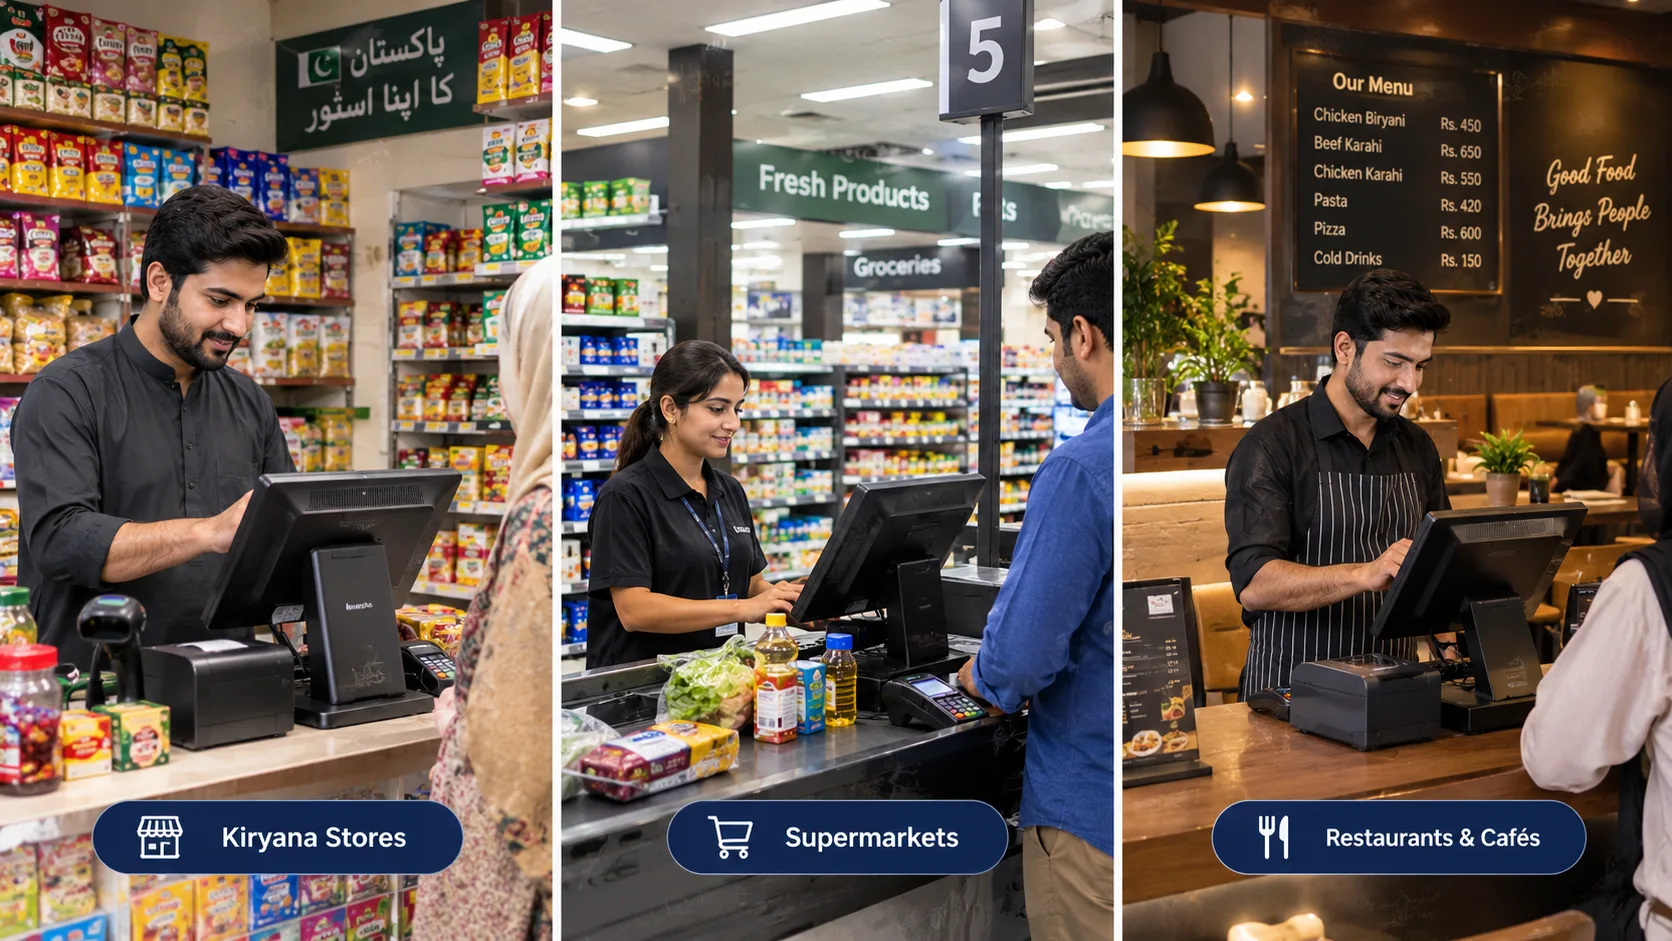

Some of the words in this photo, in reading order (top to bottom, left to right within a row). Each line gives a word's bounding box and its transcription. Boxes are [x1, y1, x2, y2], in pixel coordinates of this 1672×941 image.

[350, 26, 445, 77] پاکستان
[967, 15, 1004, 84] 5
[432, 73, 453, 104] کا
[1333, 72, 1364, 91] Our
[1369, 76, 1413, 96] Menu
[384, 80, 418, 120] اپنا
[1314, 107, 1362, 123] Chicken
[1366, 111, 1405, 128] Biryani
[1441, 117, 1457, 130] Rs.
[1460, 119, 1481, 132] 450
[1315, 136, 1342, 150] Beef
[1346, 138, 1381, 152] Karahi
[1441, 144, 1457, 157] Rs.
[1460, 146, 1481, 158] 650
[760, 164, 825, 197] Fresh
[833, 175, 929, 211] Products
[1314, 164, 1362, 179] Chicken
[1366, 167, 1402, 181] Karahi
[1441, 171, 1457, 184] Rs.
[1460, 172, 1481, 185] 550
[1546, 157, 1592, 195] Good
[1596, 154, 1637, 184] Food
[1315, 193, 1347, 207] Pasta
[1442, 199, 1457, 211] Rs.
[1460, 200, 1481, 212] 420
[1533, 203, 1593, 238] Brings
[1598, 194, 1651, 231] People
[1315, 222, 1345, 235] Pizza
[1441, 226, 1457, 239] Rs.
[1460, 227, 1481, 239] 600
[853, 255, 941, 278] Groceries
[1314, 251, 1341, 264] Cold
[1346, 251, 1382, 265] Drinks
[1442, 254, 1458, 267] Rs.
[1461, 254, 1481, 267] 150
[1557, 239, 1632, 279] Together
